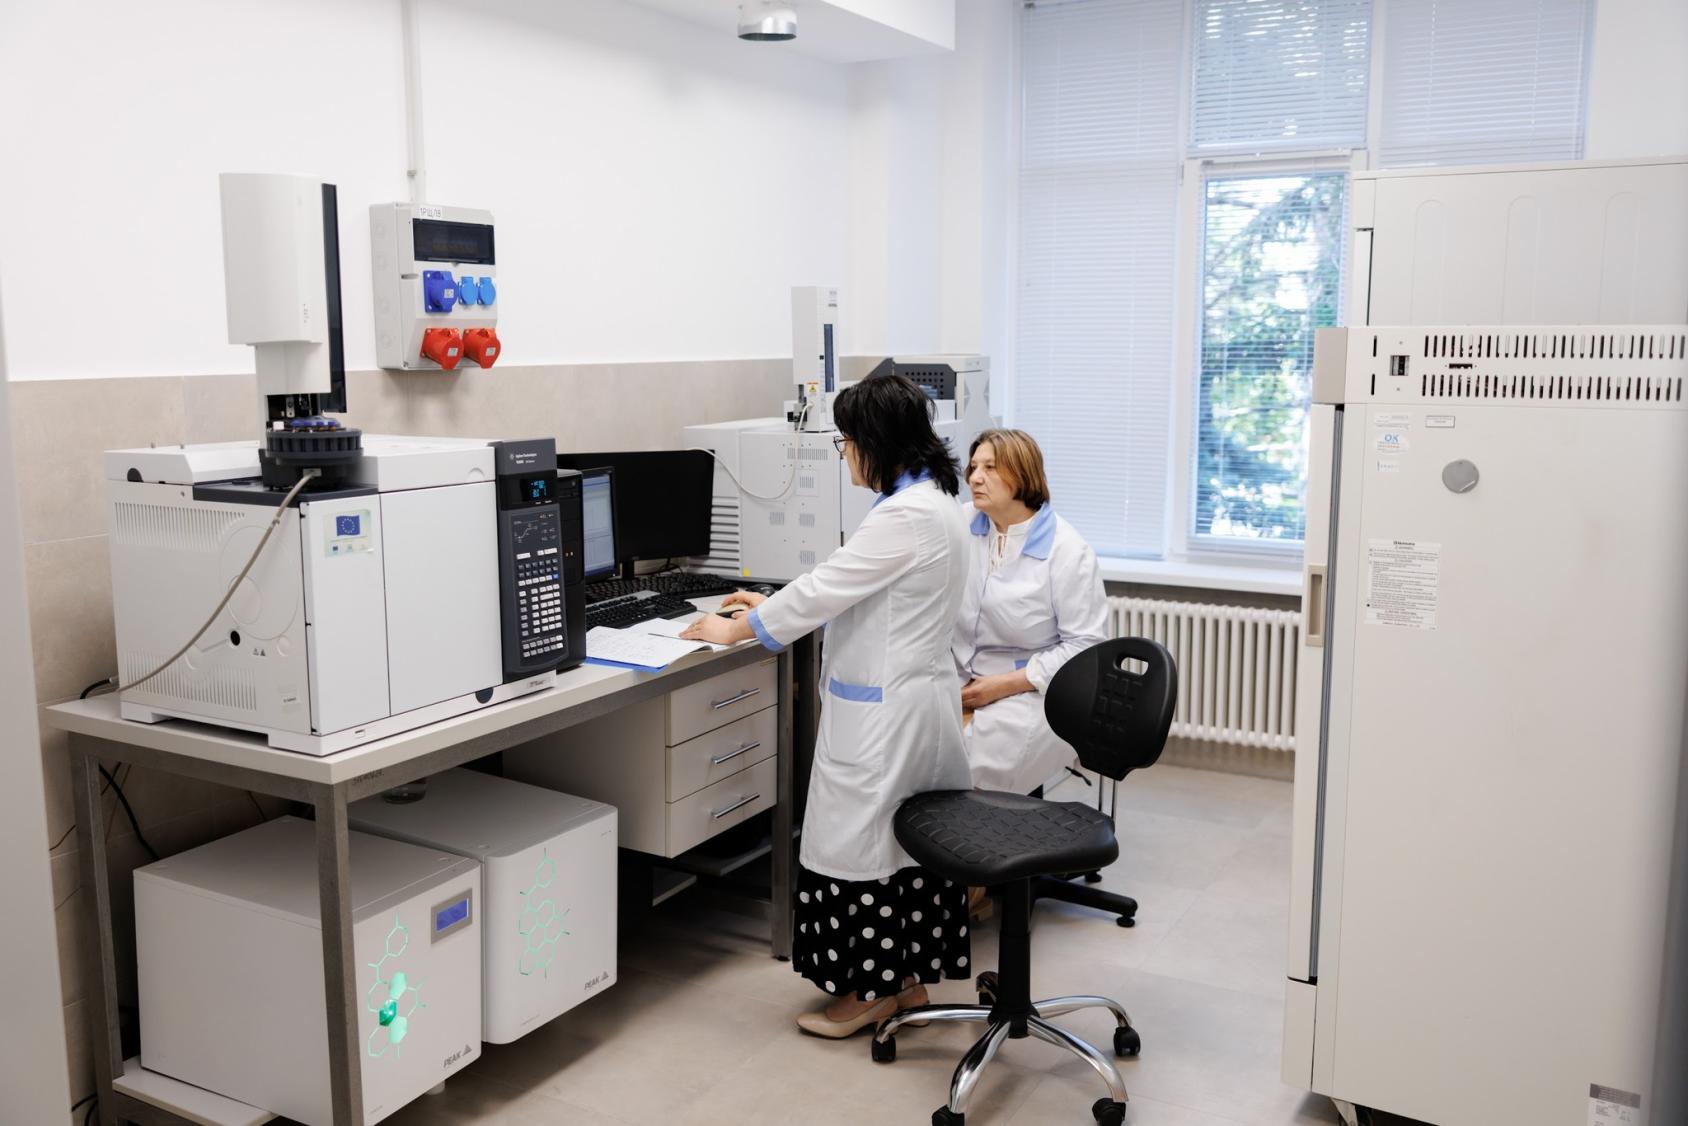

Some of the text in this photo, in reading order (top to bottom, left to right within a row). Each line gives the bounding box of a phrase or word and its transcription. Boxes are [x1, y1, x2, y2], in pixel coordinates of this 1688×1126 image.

[1384, 433, 1399, 443] OK
[584, 976, 600, 990] PEAK
[443, 1050, 462, 1068] PEAK
